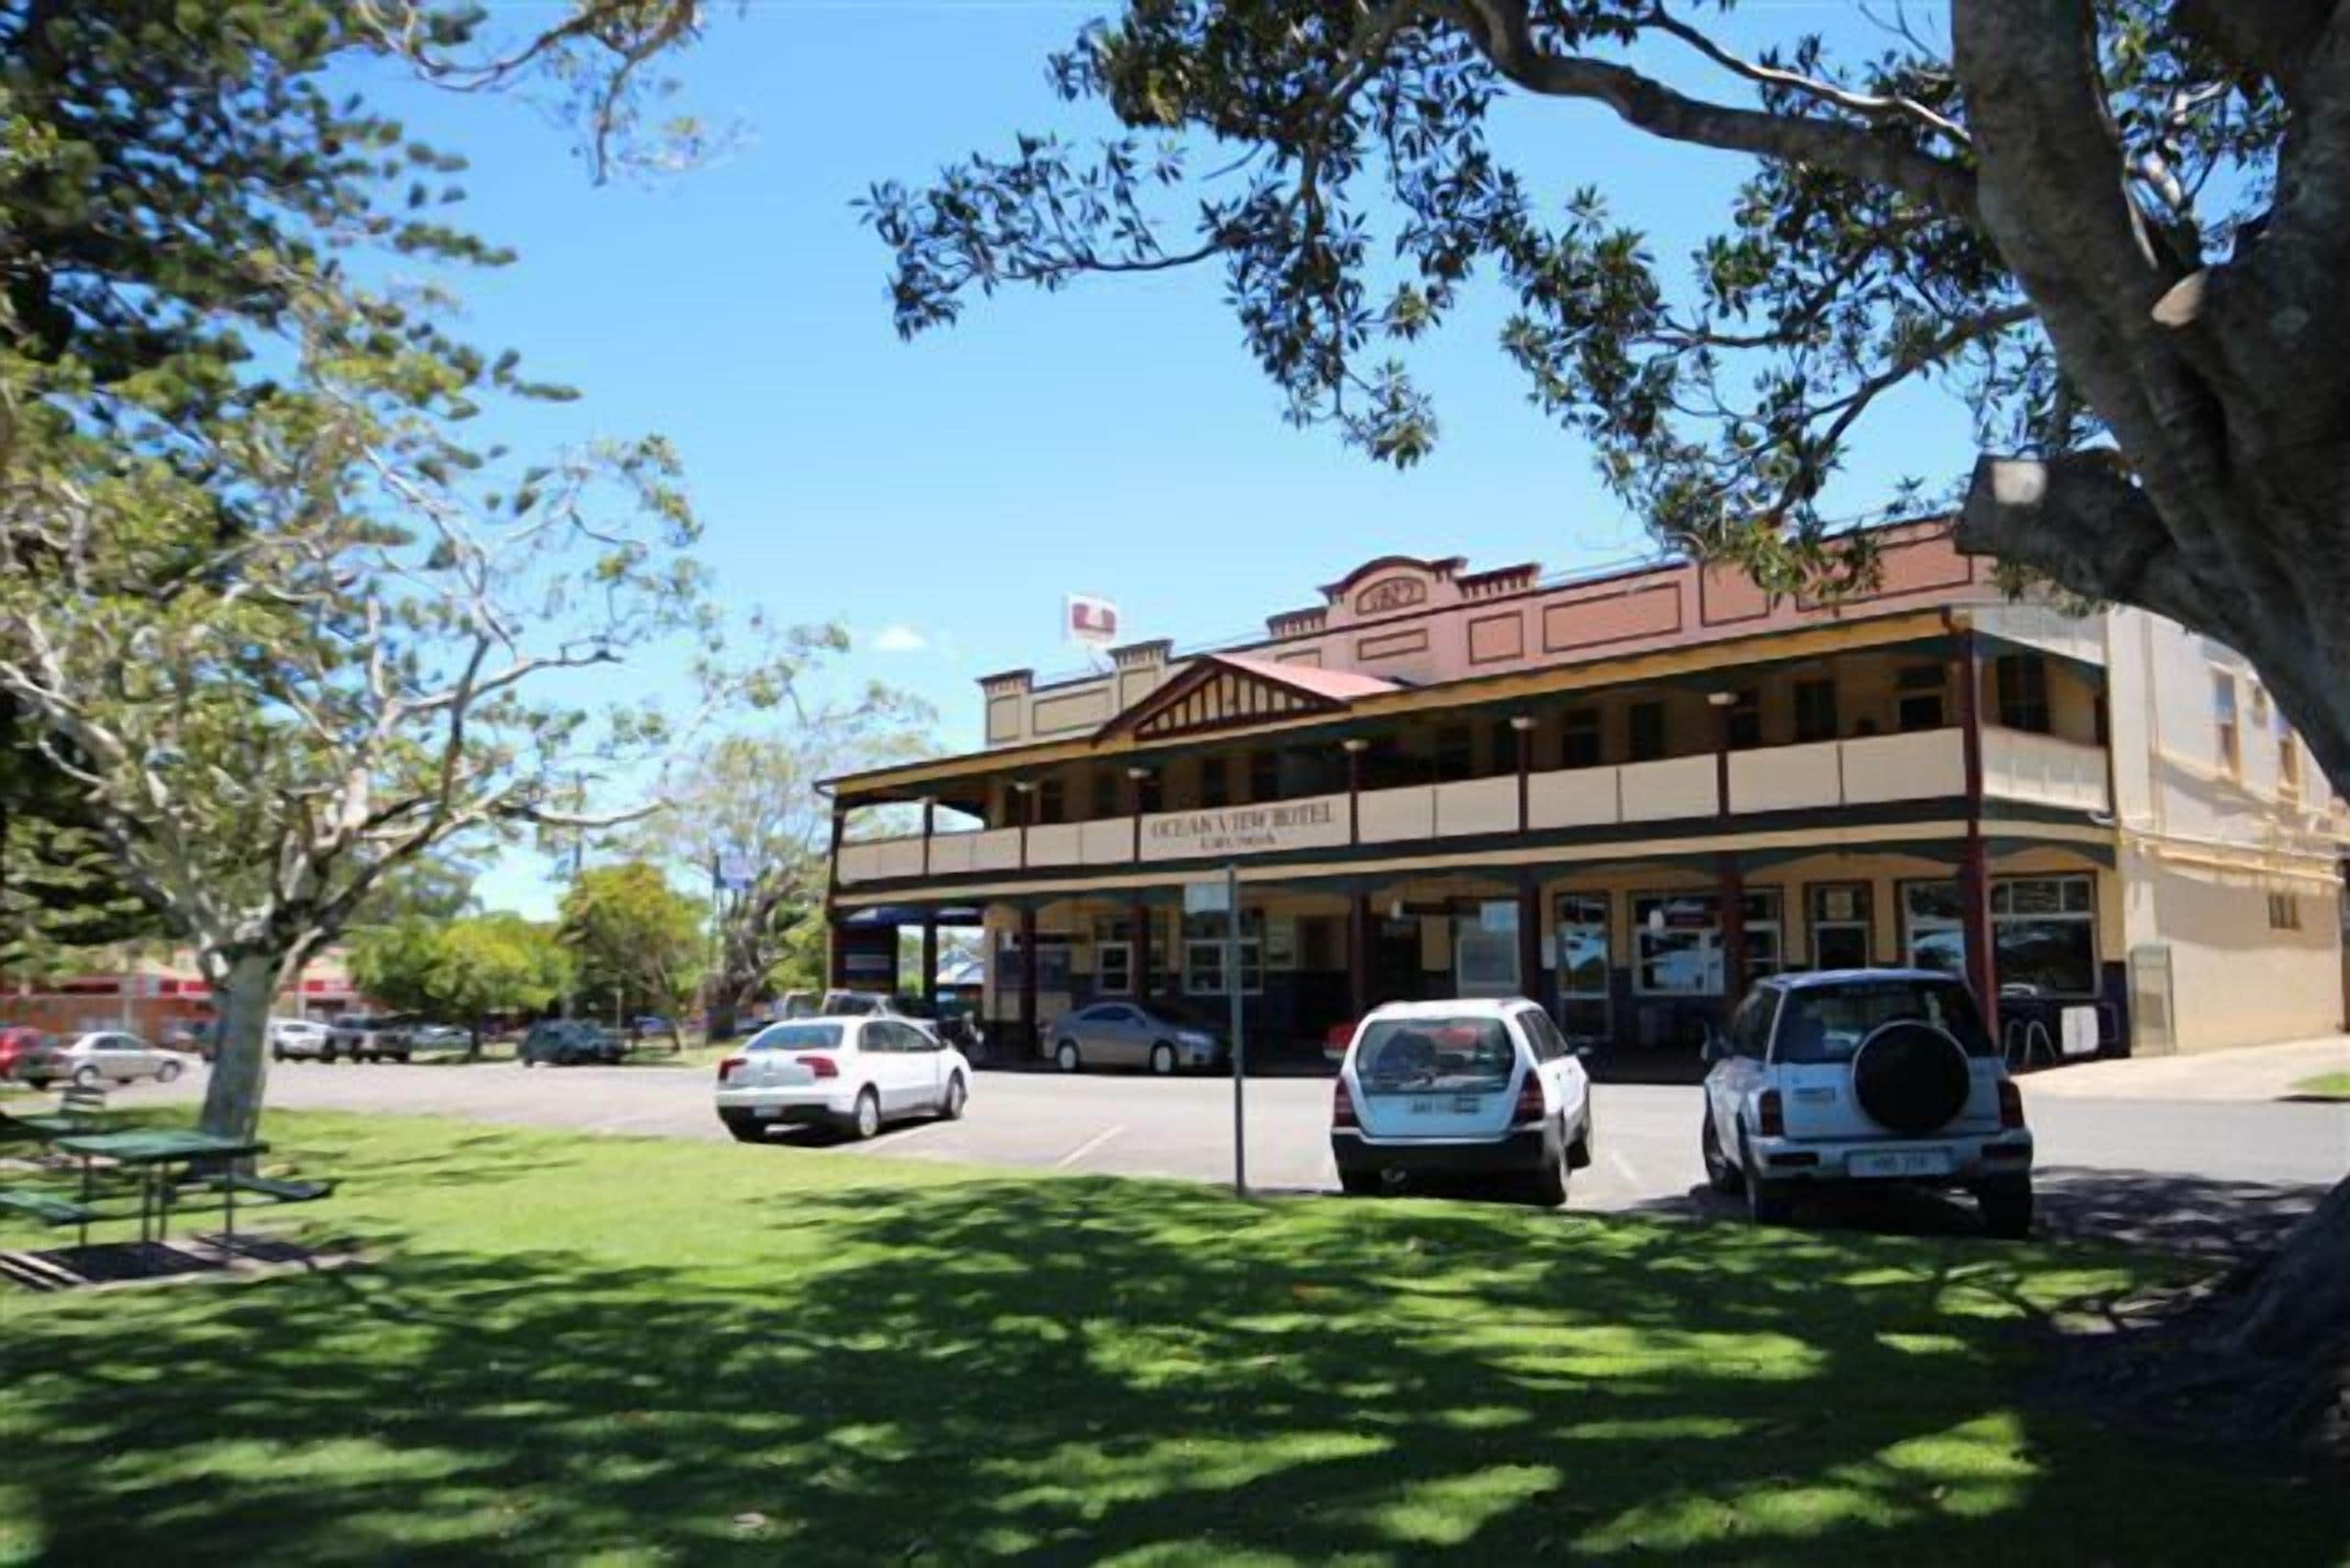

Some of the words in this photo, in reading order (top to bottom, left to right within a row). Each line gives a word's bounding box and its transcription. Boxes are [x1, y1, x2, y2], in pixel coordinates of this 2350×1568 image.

[1151, 814, 1213, 838] OCEAN
[1216, 810, 1266, 833] VIEW
[1272, 801, 1334, 827] HOTEL
